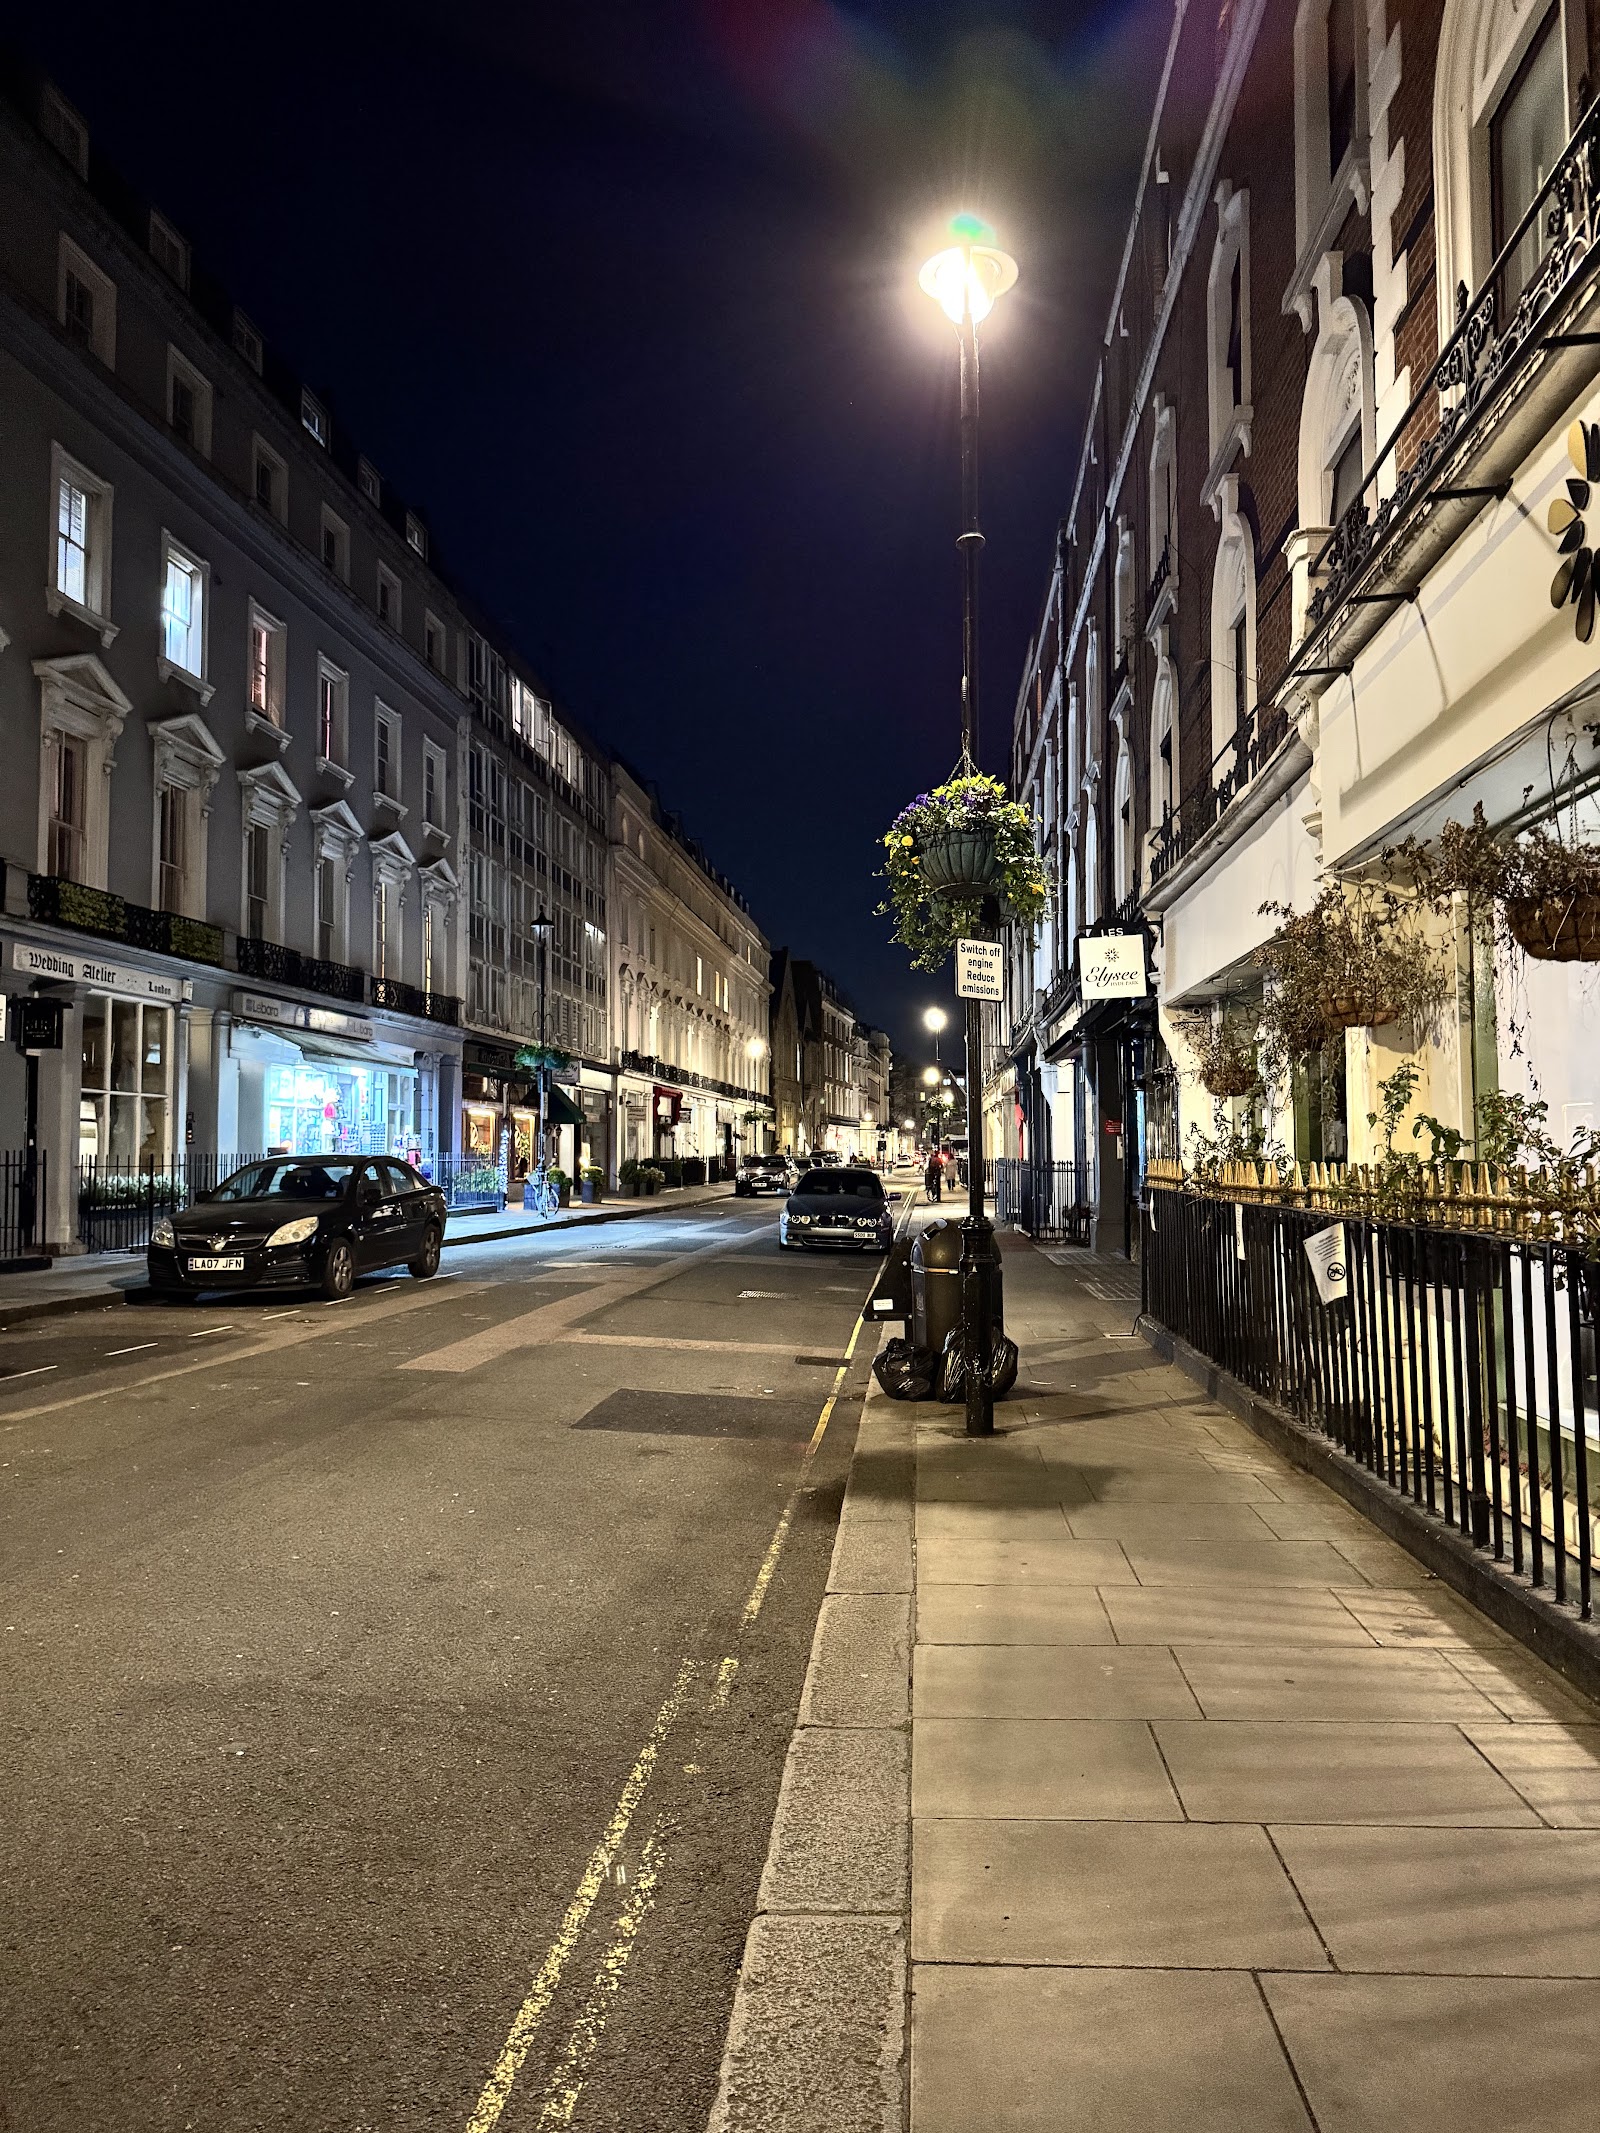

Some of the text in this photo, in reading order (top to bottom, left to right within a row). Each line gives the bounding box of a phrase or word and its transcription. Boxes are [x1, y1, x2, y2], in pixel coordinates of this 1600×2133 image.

[1101, 927, 1124, 938] LES
[960, 942, 1001, 957] Switch off
[967, 958, 994, 969] engine
[29, 952, 172, 996] Wedding Atelier London
[966, 970, 996, 983] Reduce
[962, 983, 1000, 996] emissions
[252, 999, 279, 1018] Lebara
[353, 1021, 373, 1037] Lbara
[194, 1259, 242, 1269] LA07 JFN
